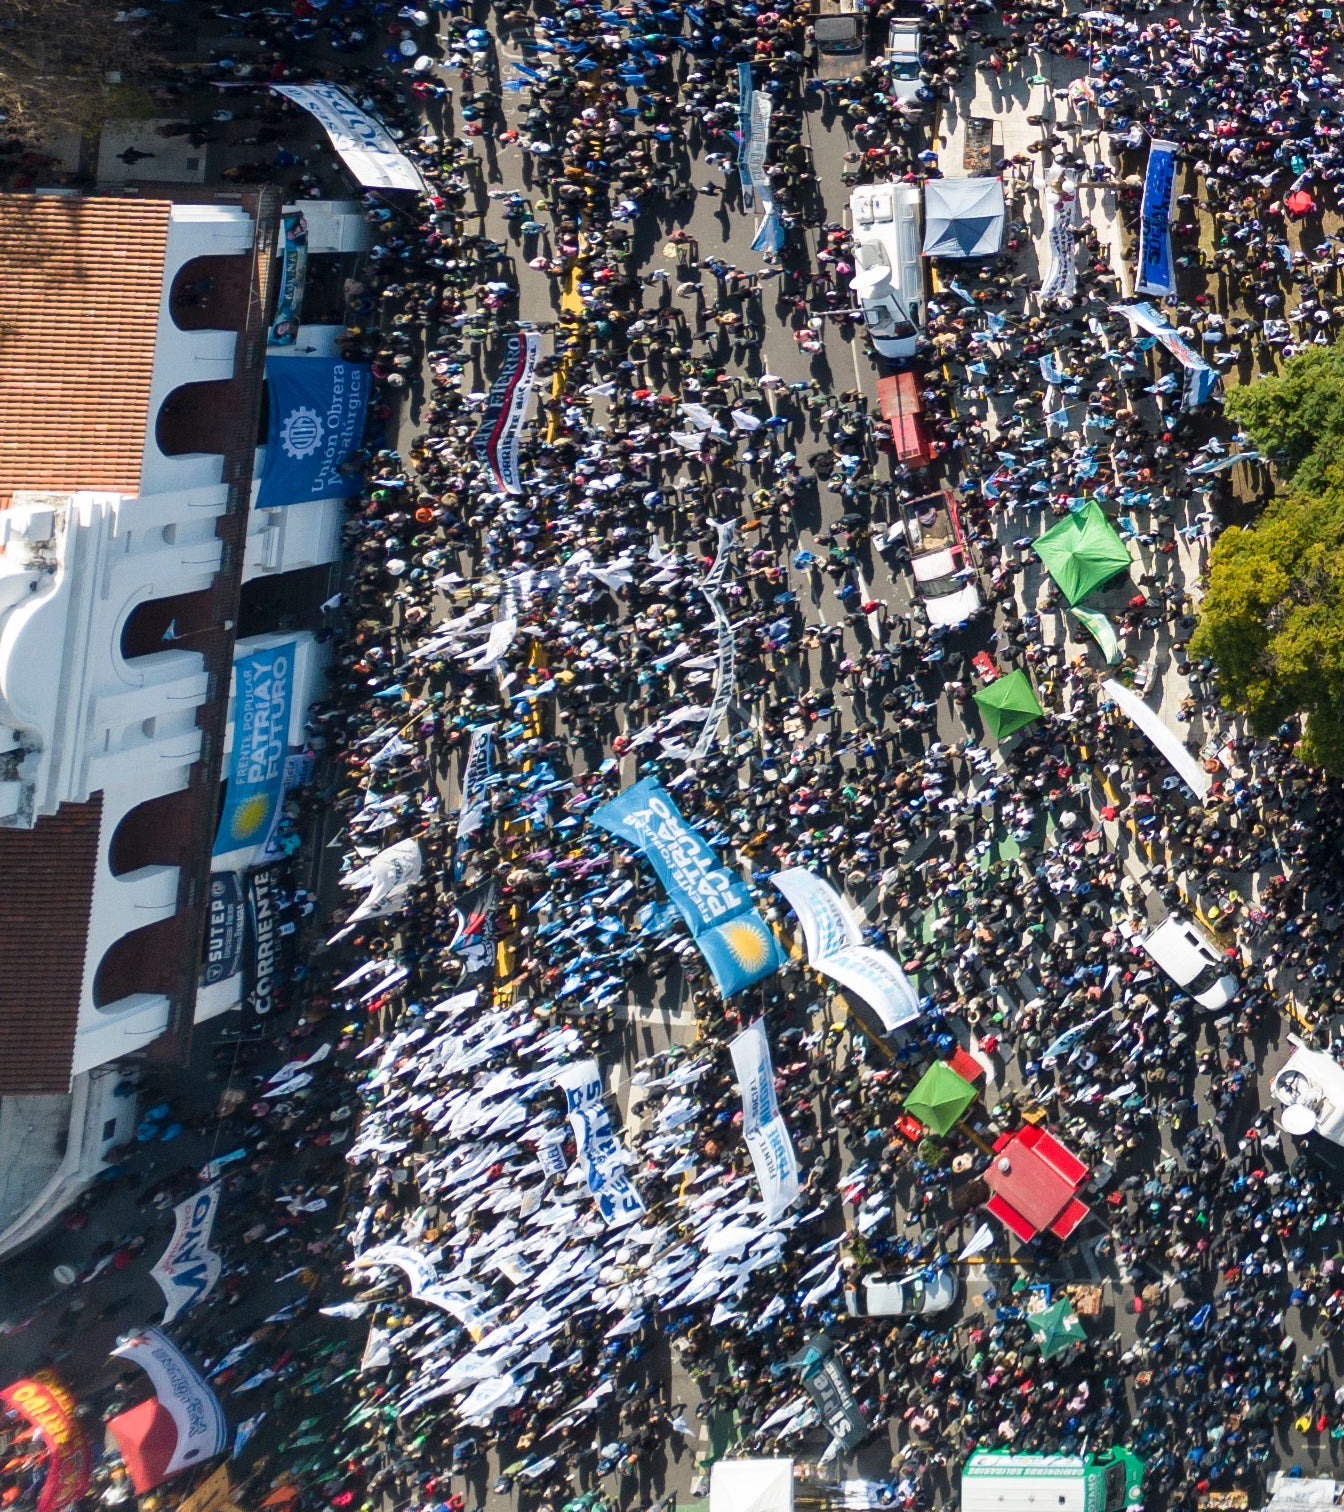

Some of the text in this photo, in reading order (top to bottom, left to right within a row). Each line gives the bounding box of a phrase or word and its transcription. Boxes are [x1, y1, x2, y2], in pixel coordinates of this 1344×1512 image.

[312, 364, 345, 493] Unión Obrera
[236, 670, 255, 785] FRENTE POPULAR
[247, 688, 271, 783] PATRIA
[263, 656, 288, 785] FUTURO
[648, 796, 742, 910] FUTURO
[657, 825, 728, 919] PATRIA
[208, 900, 225, 962] SUTEP
[254, 871, 273, 1015] CORRIENTE
[763, 1135, 781, 1180] FRENTE
[173, 1192, 213, 1304] MAYO
[968, 1467, 1023, 1476] SOLIDARIOS
